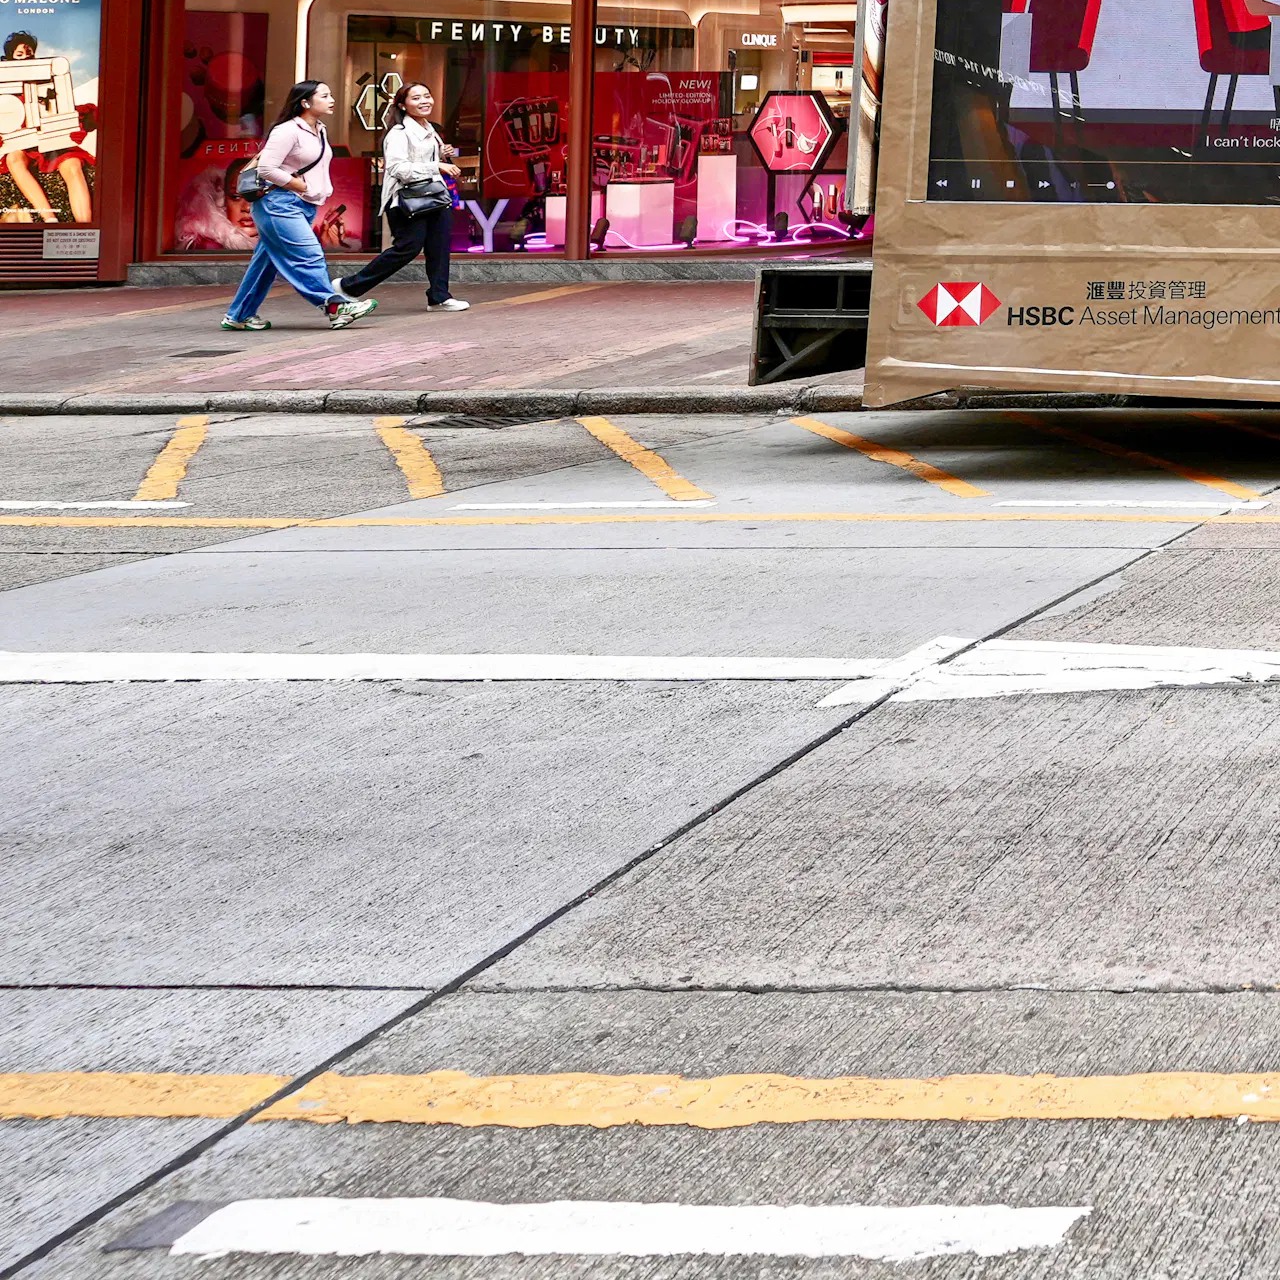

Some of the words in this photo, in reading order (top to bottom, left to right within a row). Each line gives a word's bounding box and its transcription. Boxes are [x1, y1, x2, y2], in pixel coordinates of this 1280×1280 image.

[430, 22, 523, 42] FENTY
[542, 24, 639, 46] BEUTY
[741, 33, 777, 47] CLINIQUE
[679, 79, 712, 90] NEW!
[205, 142, 263, 154] FENTY
[1205, 136, 1209, 147] I
[1213, 135, 1249, 148] can't
[1252, 136, 1280, 148] lock
[1007, 306, 1075, 326] HSBC
[1078, 305, 1138, 326] Asset
